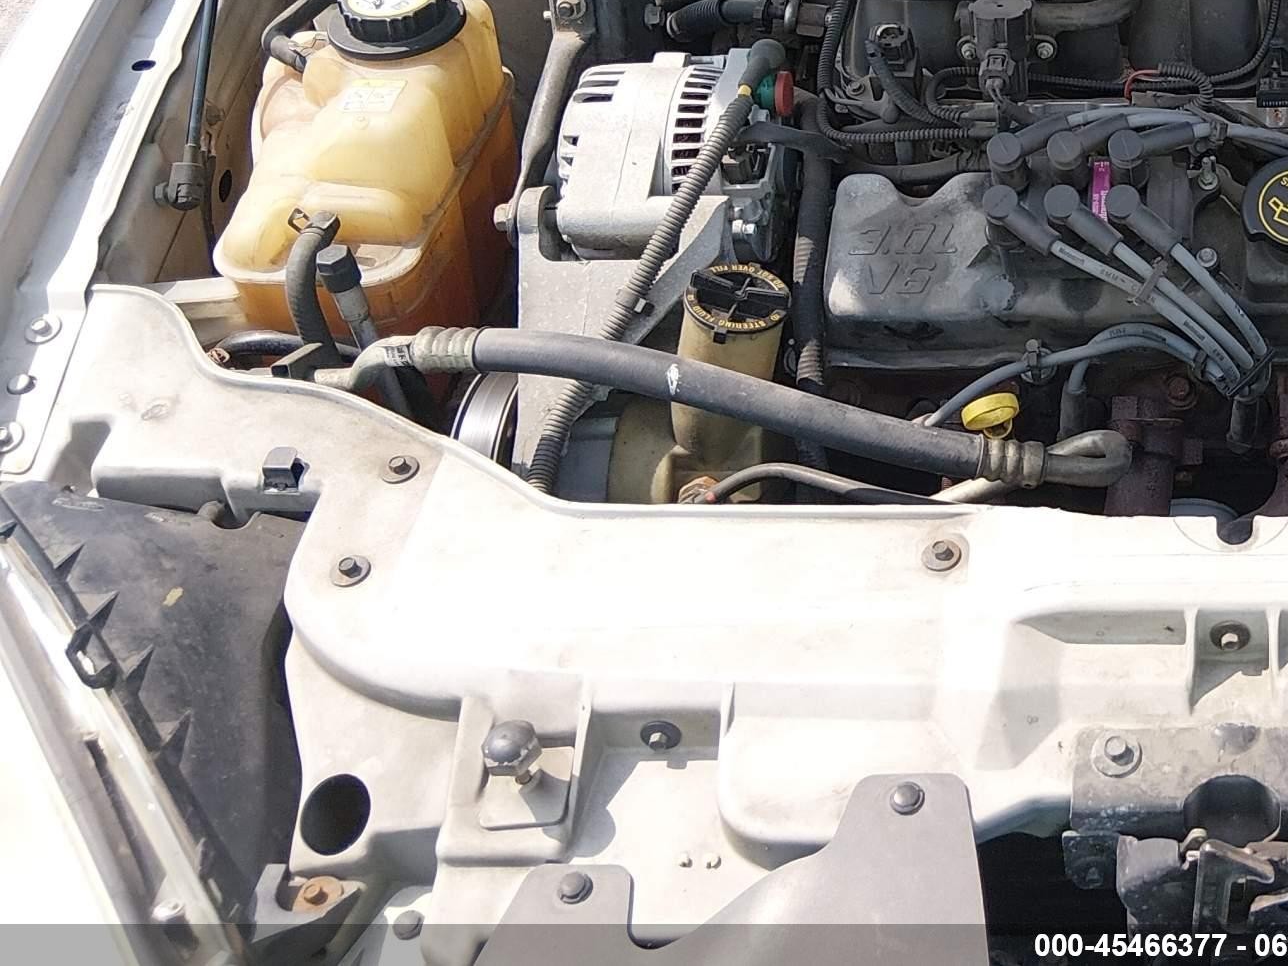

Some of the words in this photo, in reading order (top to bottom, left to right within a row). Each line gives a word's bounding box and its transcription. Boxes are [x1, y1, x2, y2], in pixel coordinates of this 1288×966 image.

[848, 222, 958, 256] 3.0L
[710, 265, 728, 273] FILL
[731, 264, 756, 273] OVER
[867, 262, 937, 295] V6
